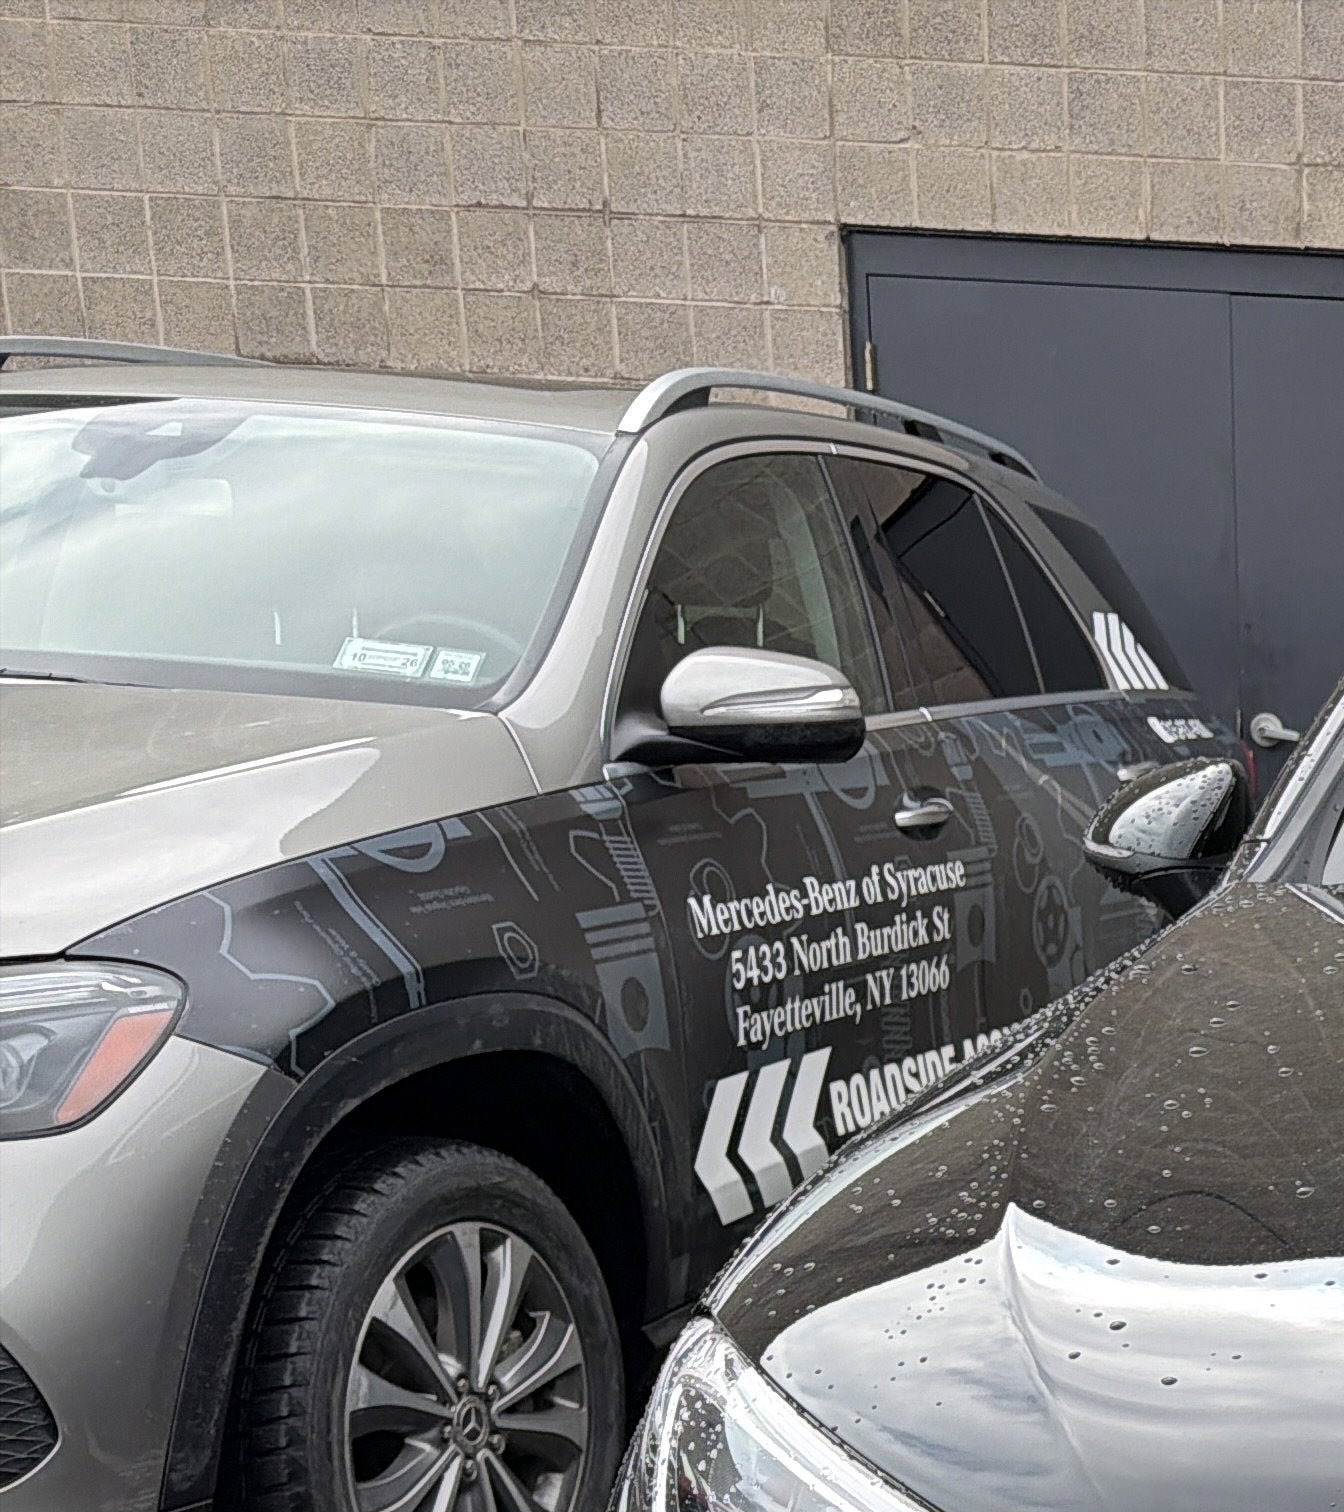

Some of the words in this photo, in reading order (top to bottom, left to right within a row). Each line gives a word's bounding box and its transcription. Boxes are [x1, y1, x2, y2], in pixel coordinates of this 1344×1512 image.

[687, 875, 860, 939] Mercedes-Benz
[861, 864, 882, 905] of
[882, 859, 968, 908] Syracuse
[730, 940, 788, 991] 5433
[789, 926, 853, 976] North
[854, 909, 930, 961] Burdick
[931, 905, 952, 943] St
[735, 979, 862, 1051] Fayetteville,
[864, 967, 895, 1011] NY
[899, 953, 951, 1001] 13066
[829, 1043, 957, 1137] ROADSIDE
